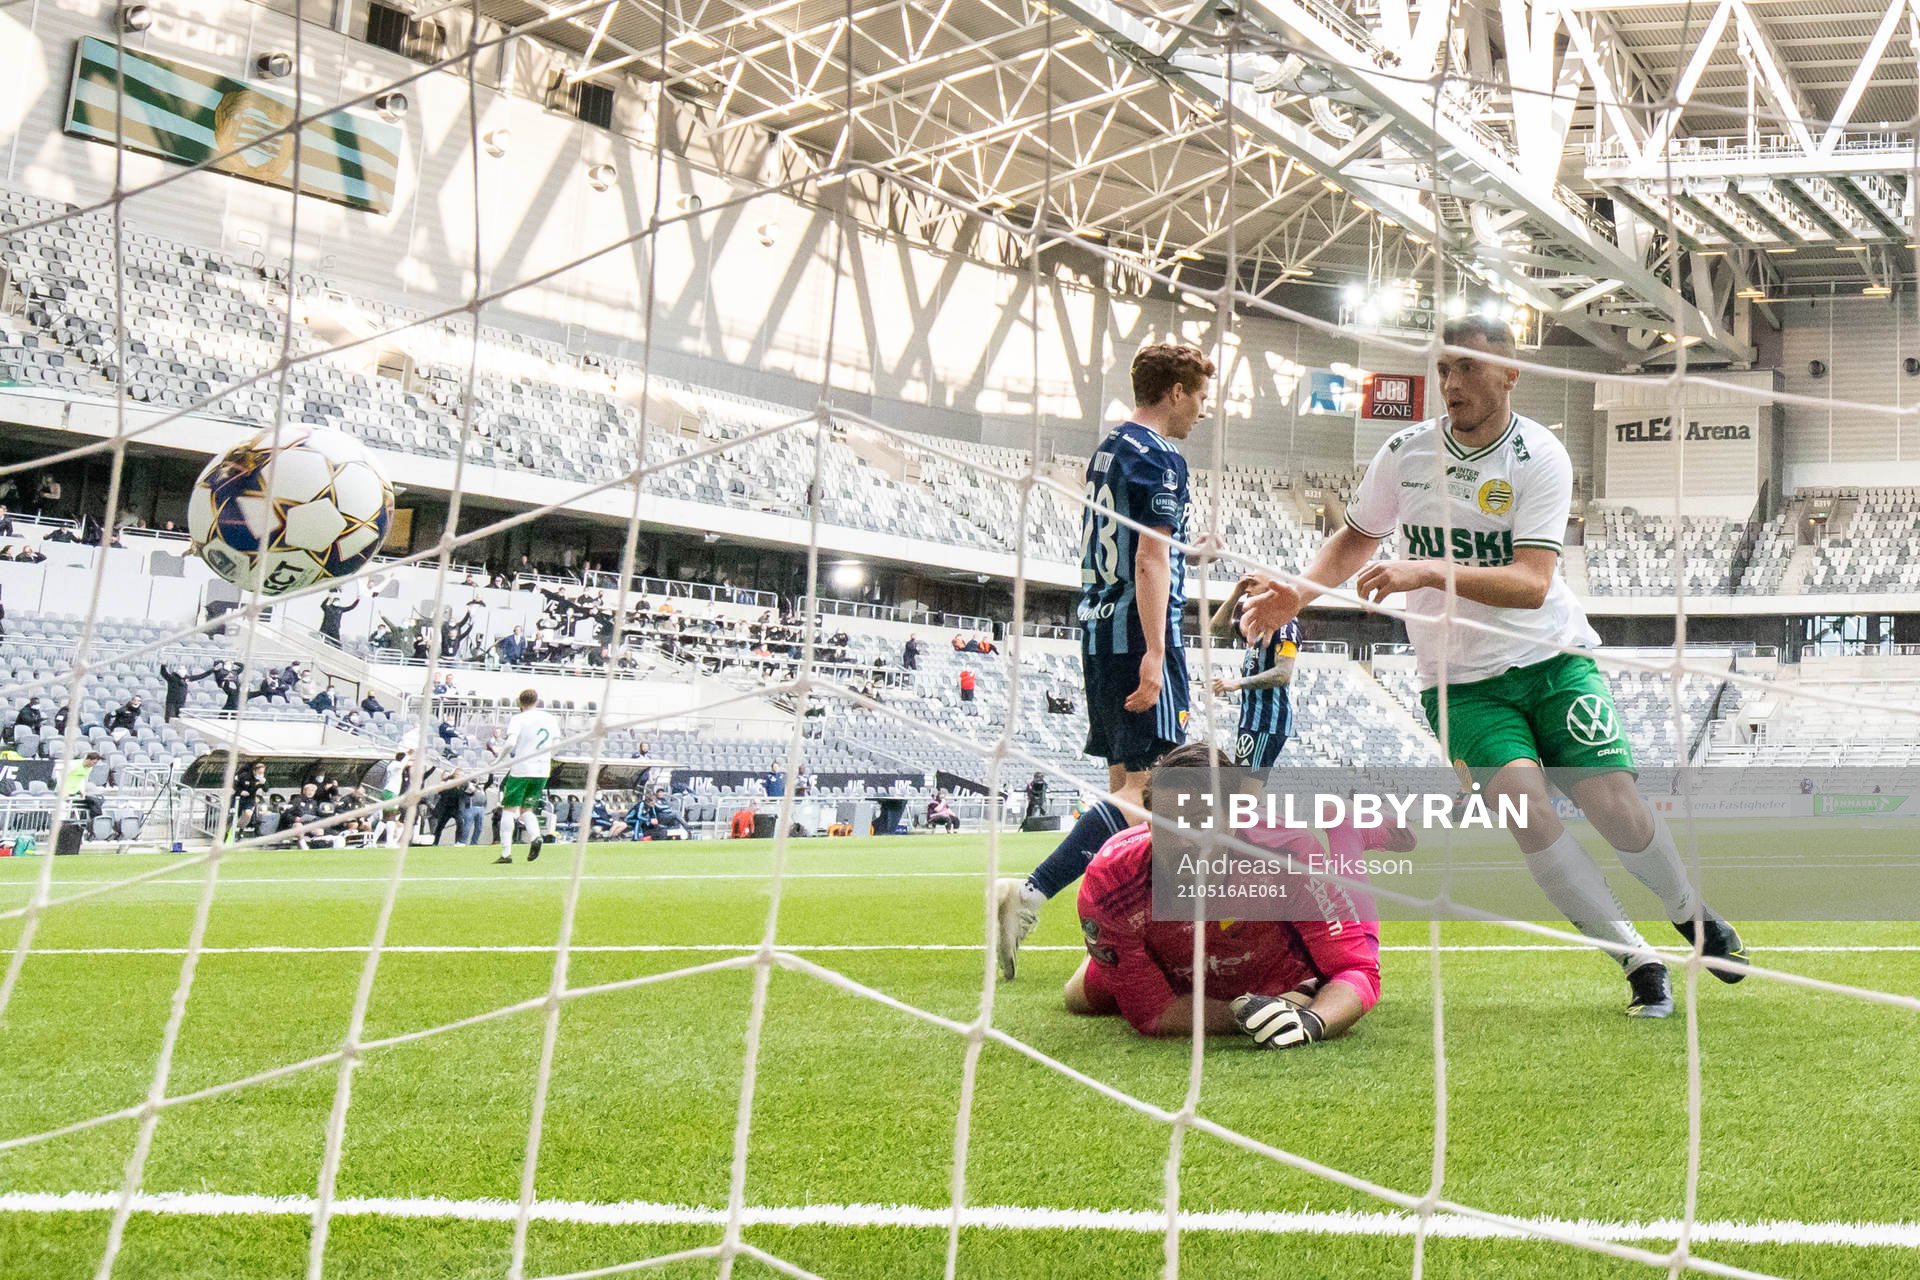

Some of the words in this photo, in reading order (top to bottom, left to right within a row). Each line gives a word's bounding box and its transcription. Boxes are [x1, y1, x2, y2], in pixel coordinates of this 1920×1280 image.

[1376, 380, 1408, 401] JOB
[1373, 404, 1412, 417] ZONE
[1685, 421, 1751, 441] Arena
[1457, 466, 1480, 478] INTER
[1402, 523, 1513, 559] HUSKI
[1682, 800, 1715, 811] Sena
